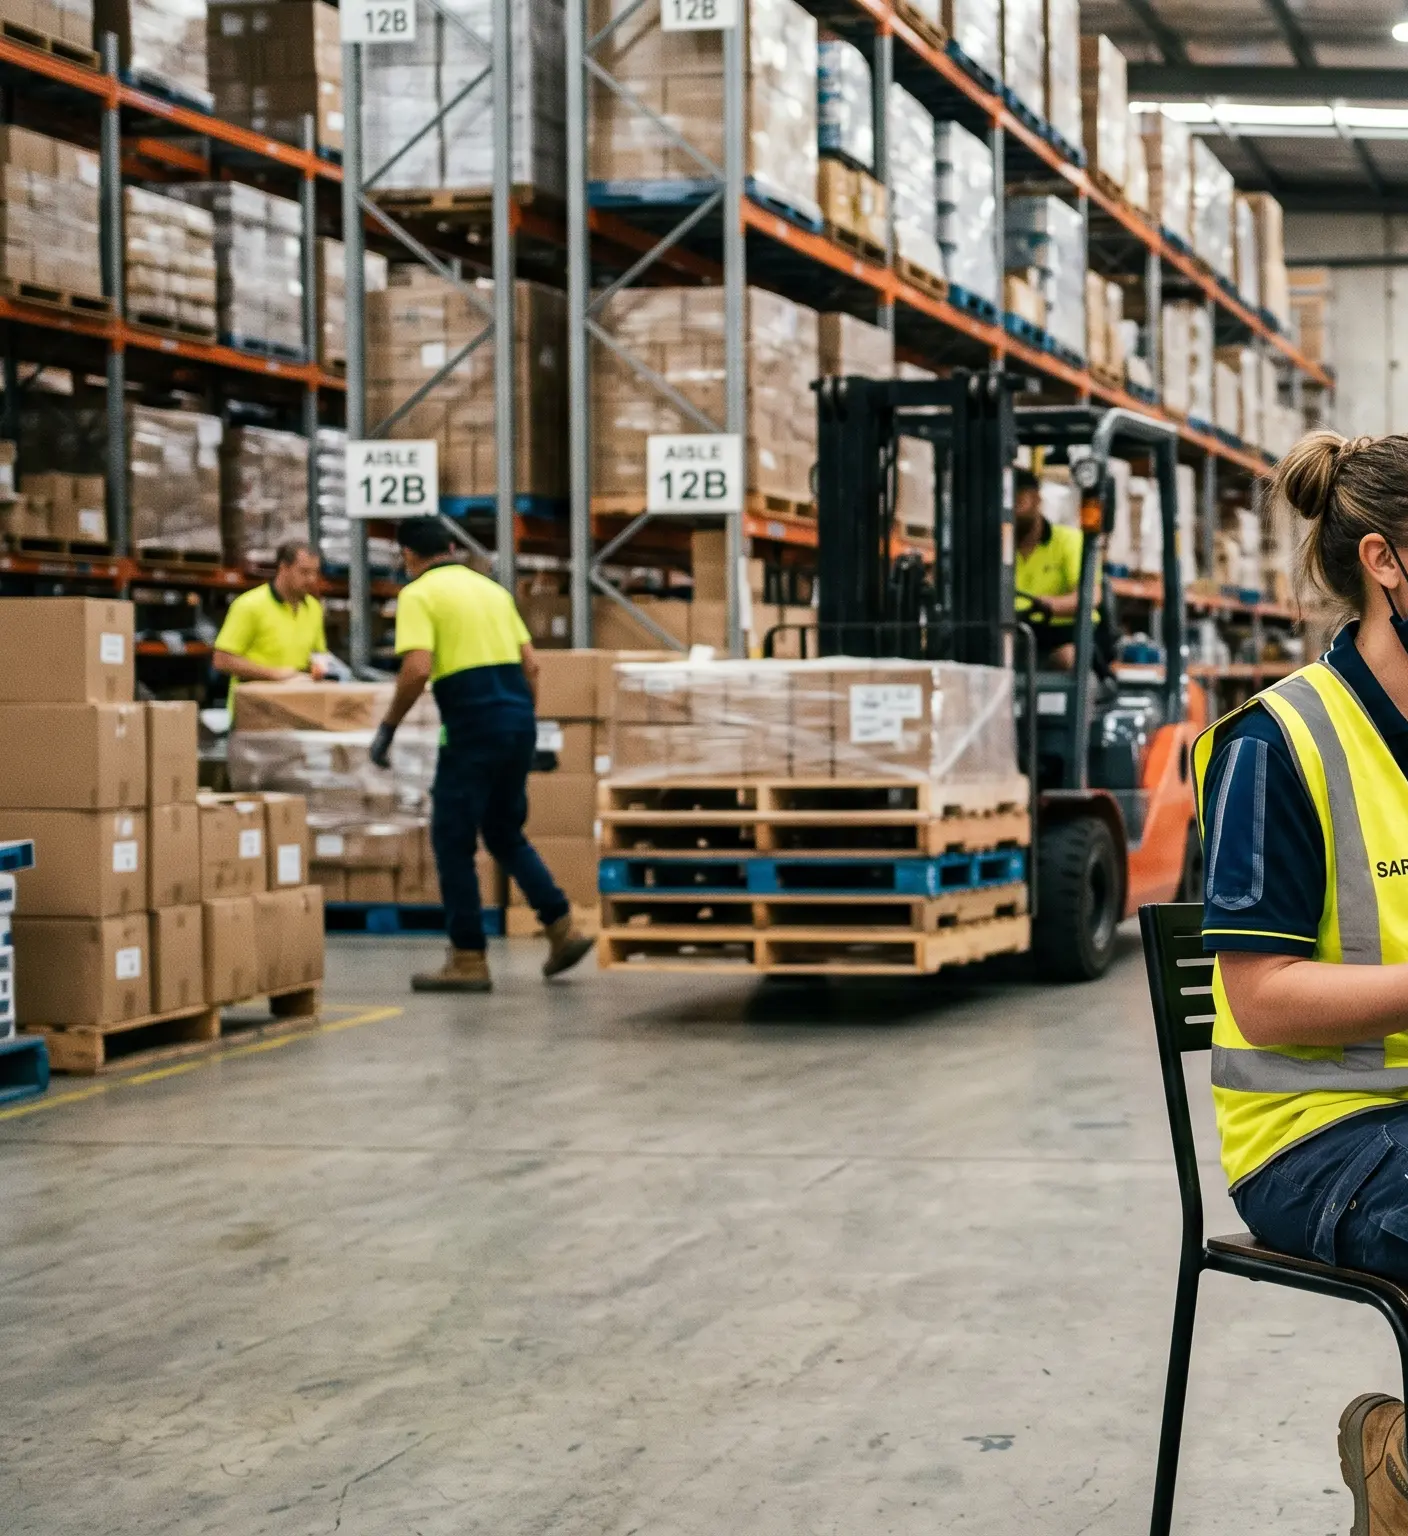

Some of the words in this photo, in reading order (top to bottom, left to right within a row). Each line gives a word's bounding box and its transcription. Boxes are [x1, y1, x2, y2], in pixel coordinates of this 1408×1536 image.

[364, 8, 408, 33] 12B
[359, 475, 426, 505] 12B
[660, 470, 728, 499] 12B
